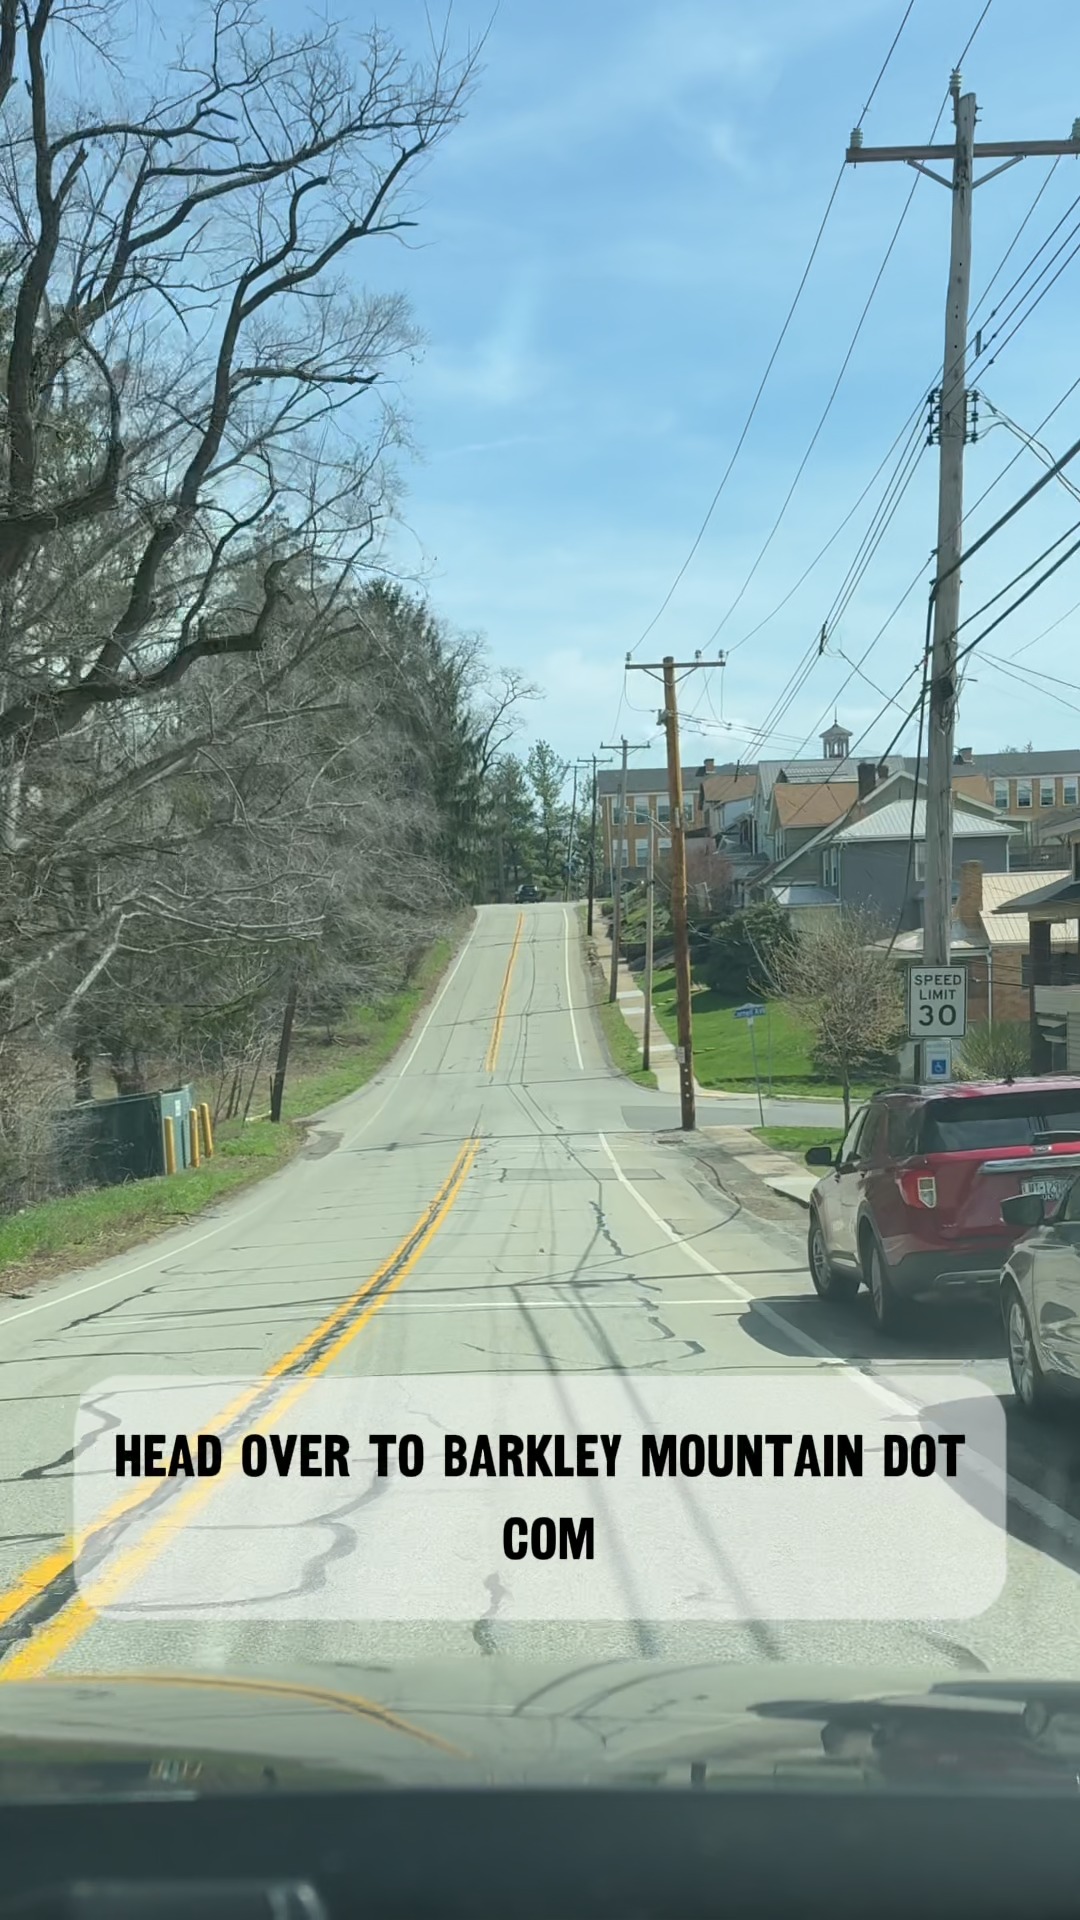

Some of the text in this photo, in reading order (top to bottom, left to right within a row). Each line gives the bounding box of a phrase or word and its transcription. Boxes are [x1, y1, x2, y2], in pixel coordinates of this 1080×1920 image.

[914, 974, 962, 986] SPEED
[919, 989, 957, 1001] LIMIT
[918, 1004, 957, 1027] 30
